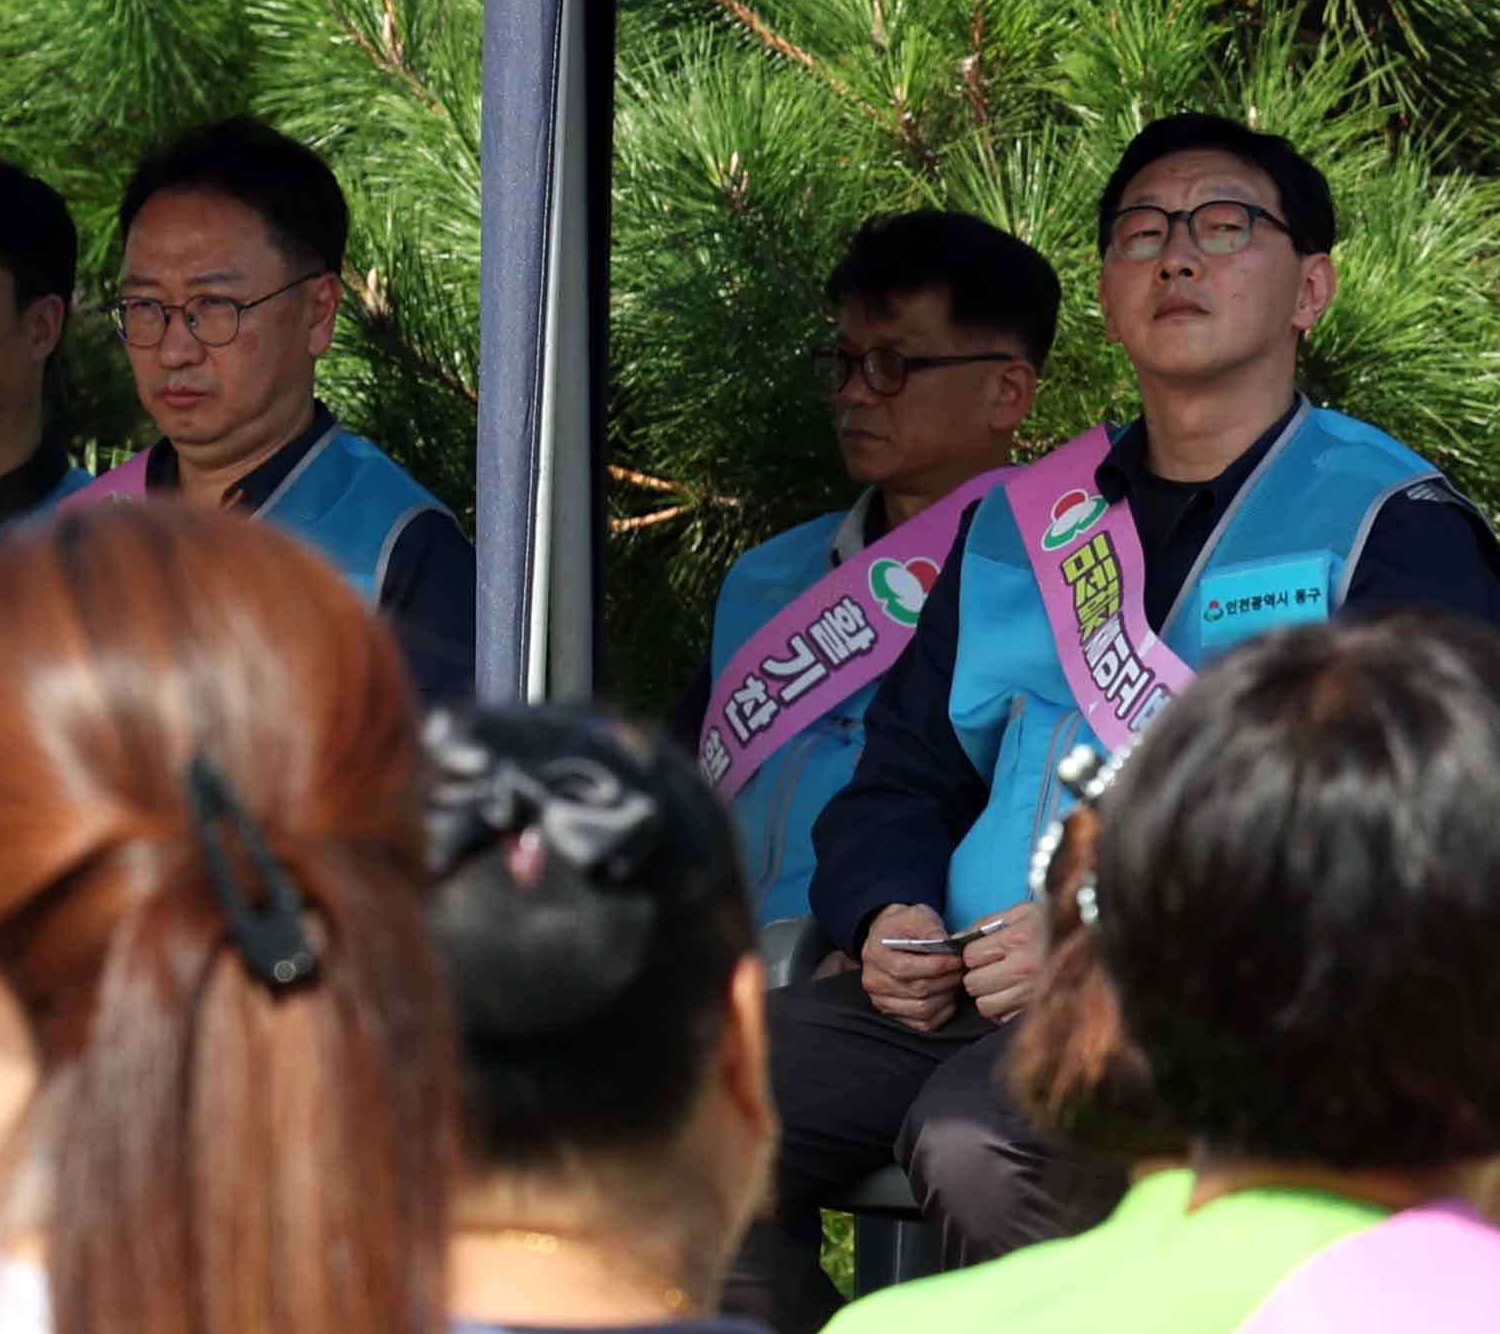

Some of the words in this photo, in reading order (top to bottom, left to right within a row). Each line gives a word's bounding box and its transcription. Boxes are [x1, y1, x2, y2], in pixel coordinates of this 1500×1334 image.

[1225, 591, 1289, 616] 인천광역시
[1295, 587, 1321, 604] 동구
[724, 593, 878, 747] 활기찬
